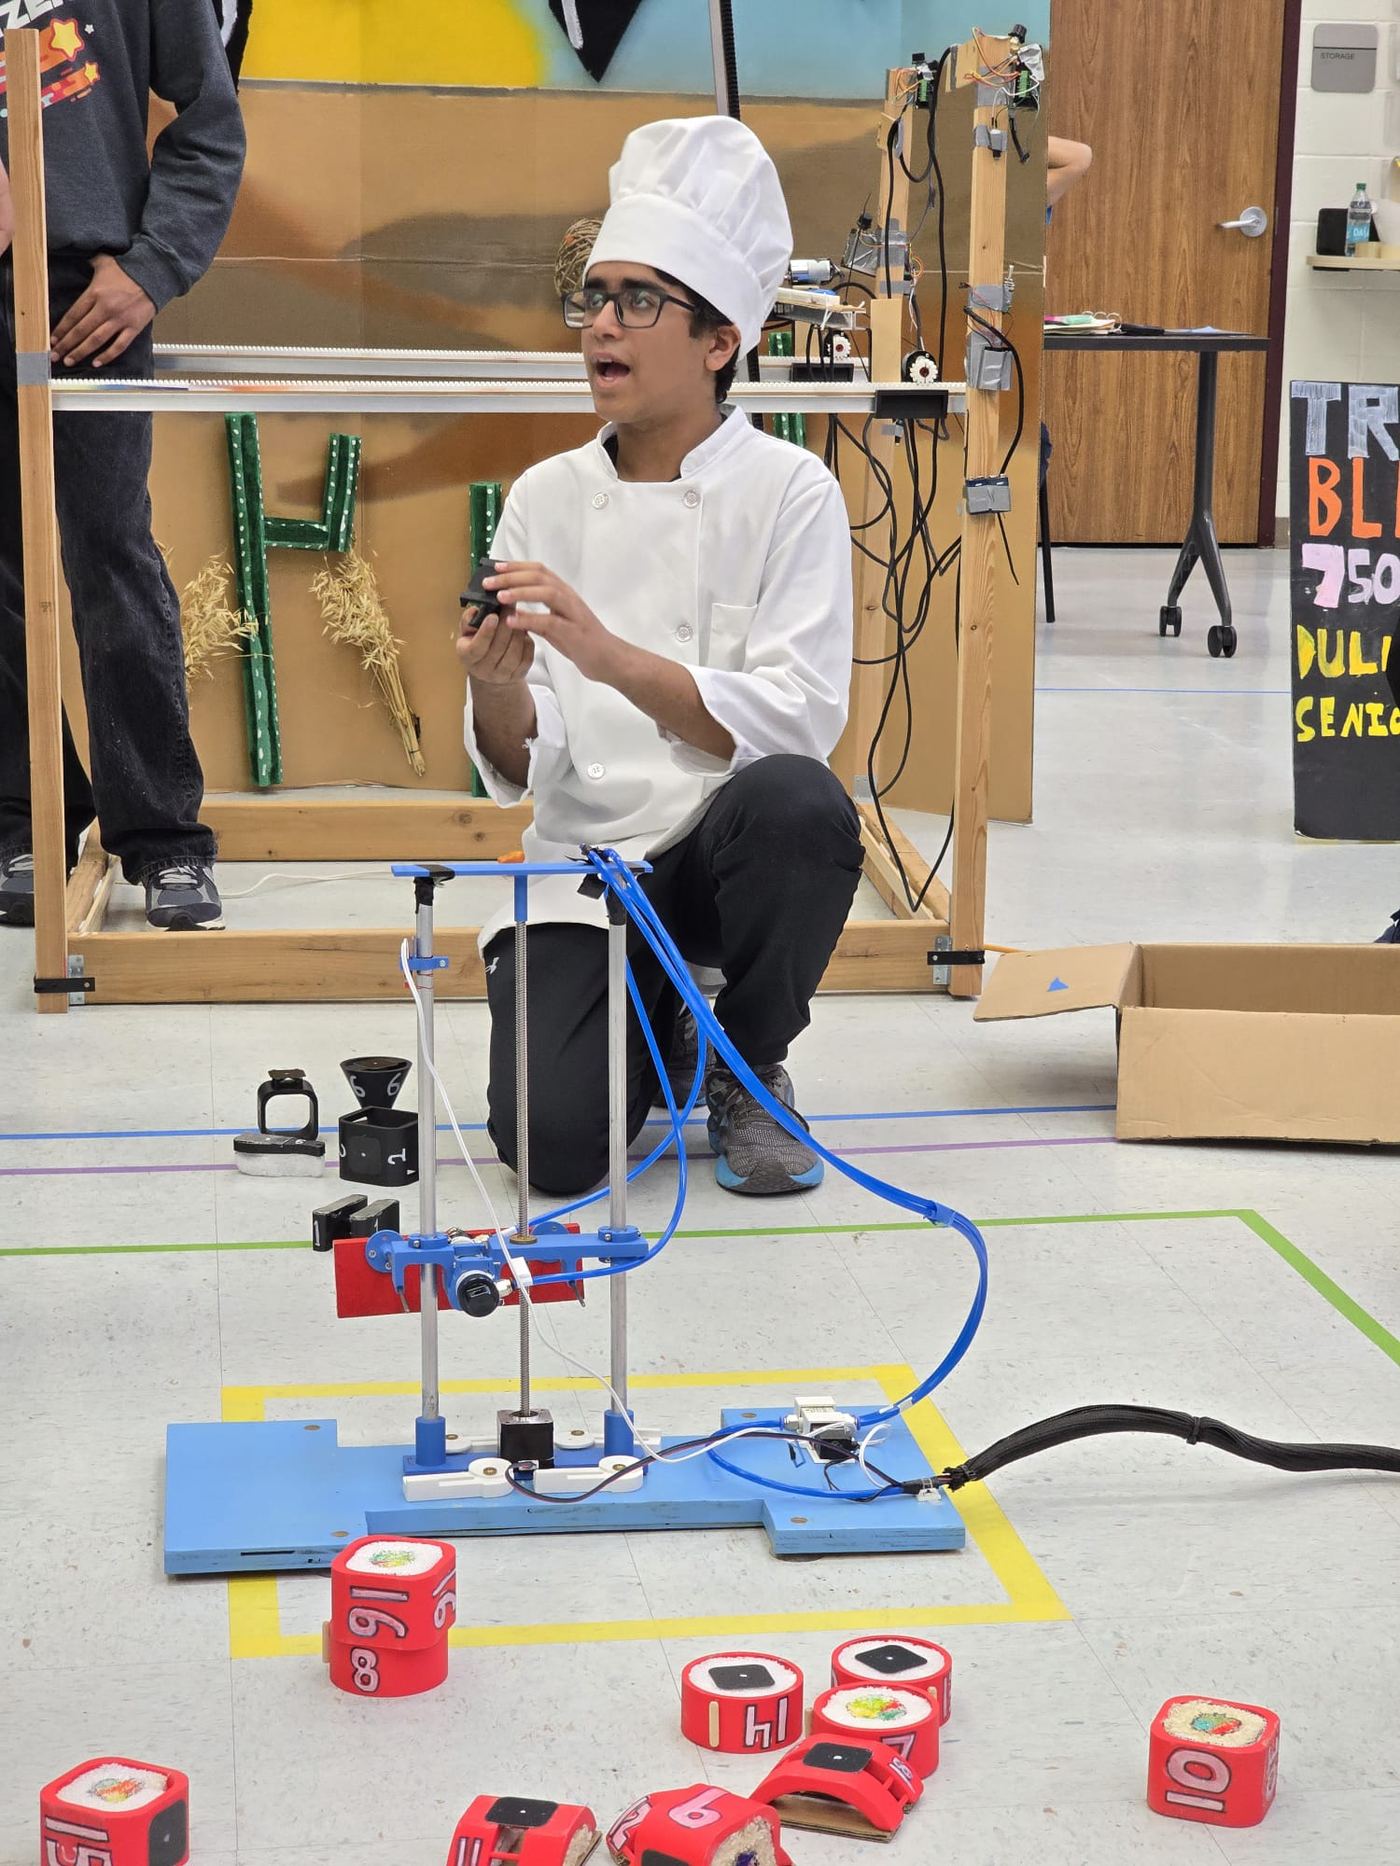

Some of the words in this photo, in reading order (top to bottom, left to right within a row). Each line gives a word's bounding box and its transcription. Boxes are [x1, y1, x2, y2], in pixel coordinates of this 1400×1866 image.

[1320, 52, 1355, 60] STORAGE
[1292, 382, 1399, 461] TR
[1309, 457, 1400, 539] BL
[387, 1072, 402, 1096] 6
[313, 1220, 321, 1247] 1
[350, 1646, 381, 1693] 8
